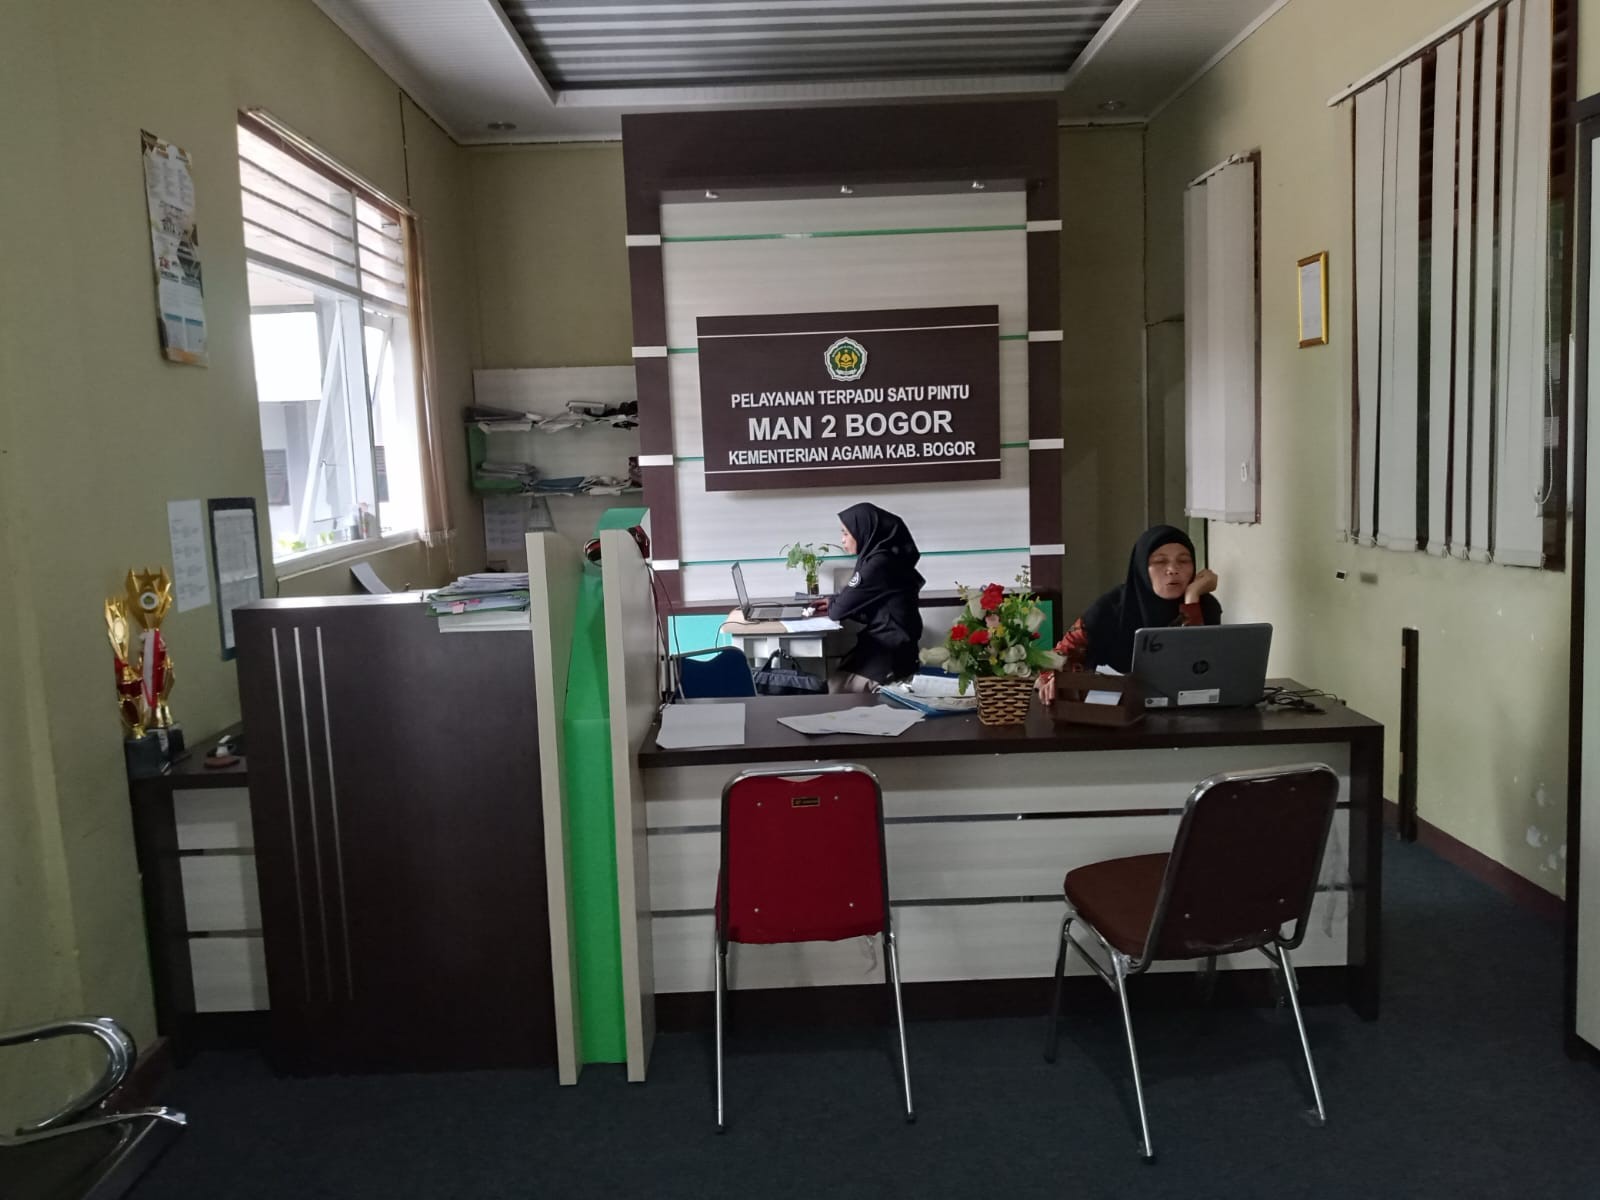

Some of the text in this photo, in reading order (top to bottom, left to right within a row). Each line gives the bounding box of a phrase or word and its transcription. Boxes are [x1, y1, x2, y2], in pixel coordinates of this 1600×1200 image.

[731, 384, 970, 408] PELAYANAN TERPADU SATU PINTU
[748, 410, 953, 441] MAN 2 BOGOR
[728, 441, 976, 465] KEMENTERIAN AGAMA KAB. BOGOR
[1142, 633, 1163, 653] 16
